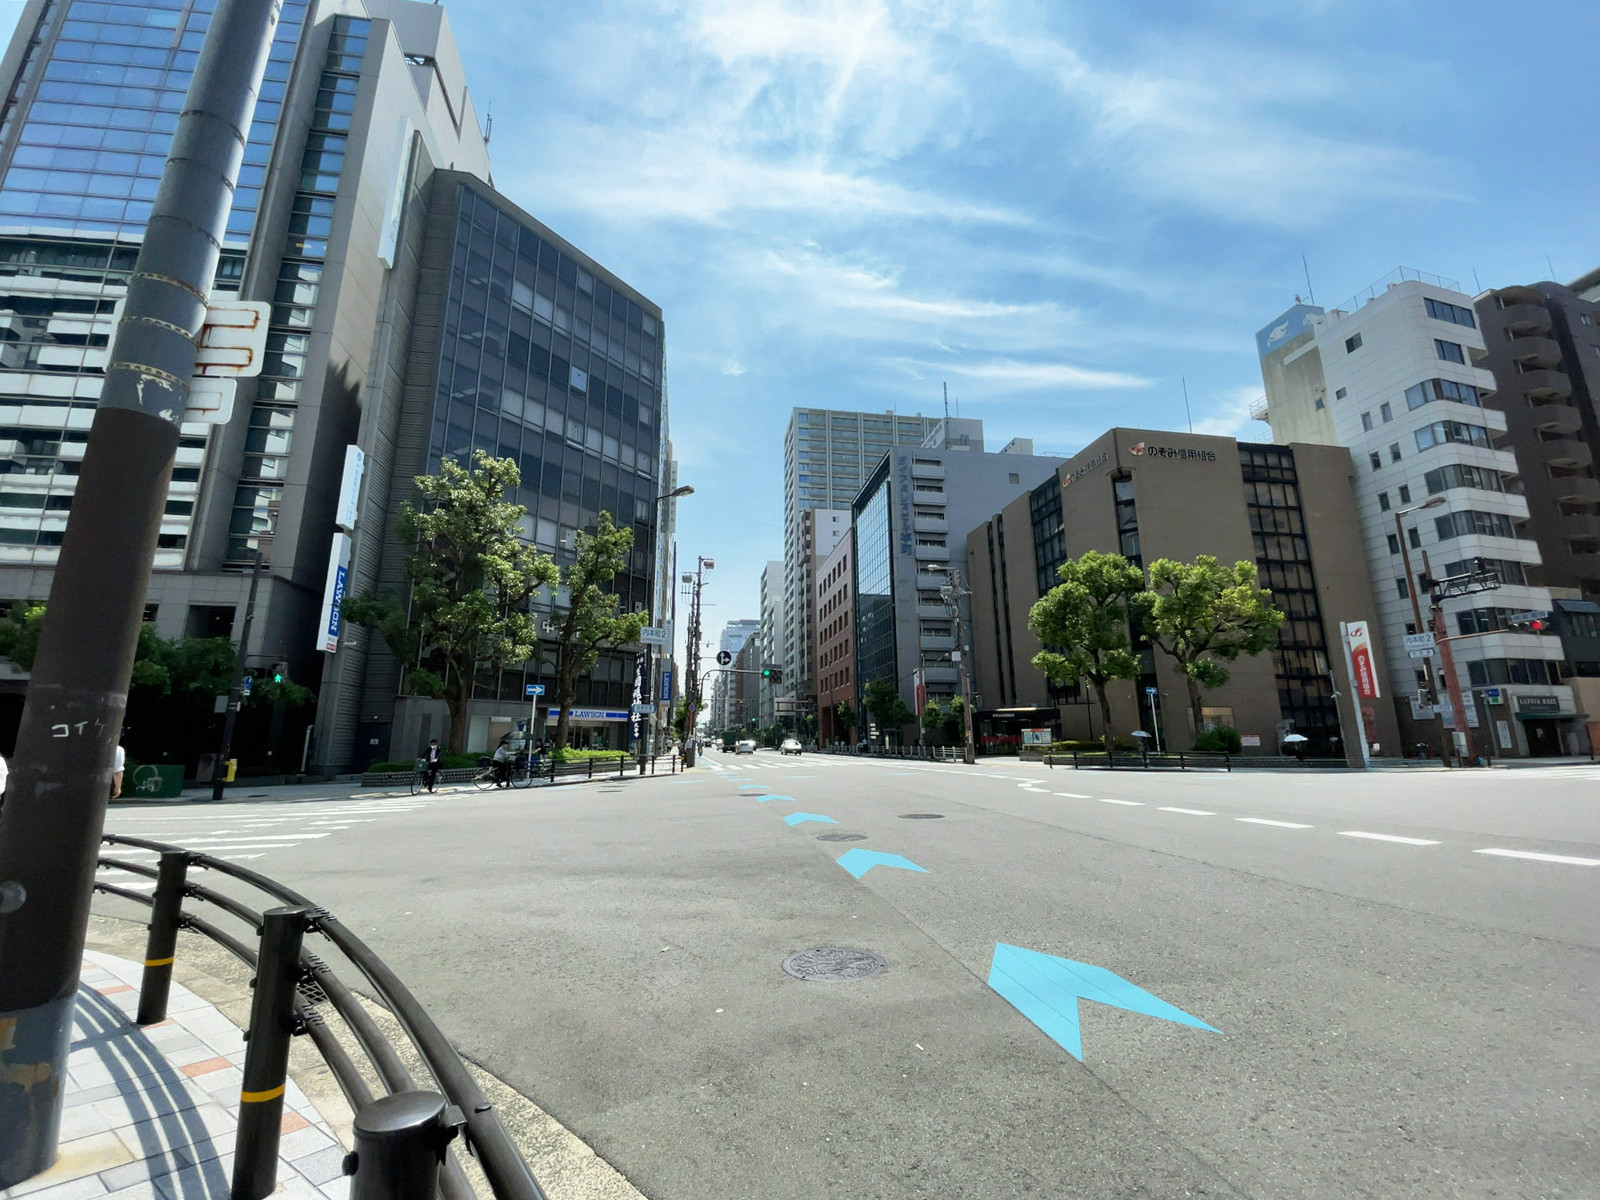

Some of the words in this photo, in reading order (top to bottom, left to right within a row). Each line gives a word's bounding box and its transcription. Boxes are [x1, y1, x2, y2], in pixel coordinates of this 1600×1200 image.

[1147, 446, 1216, 461] のぞみ信用組合
[574, 710, 605, 718] LAWSON
